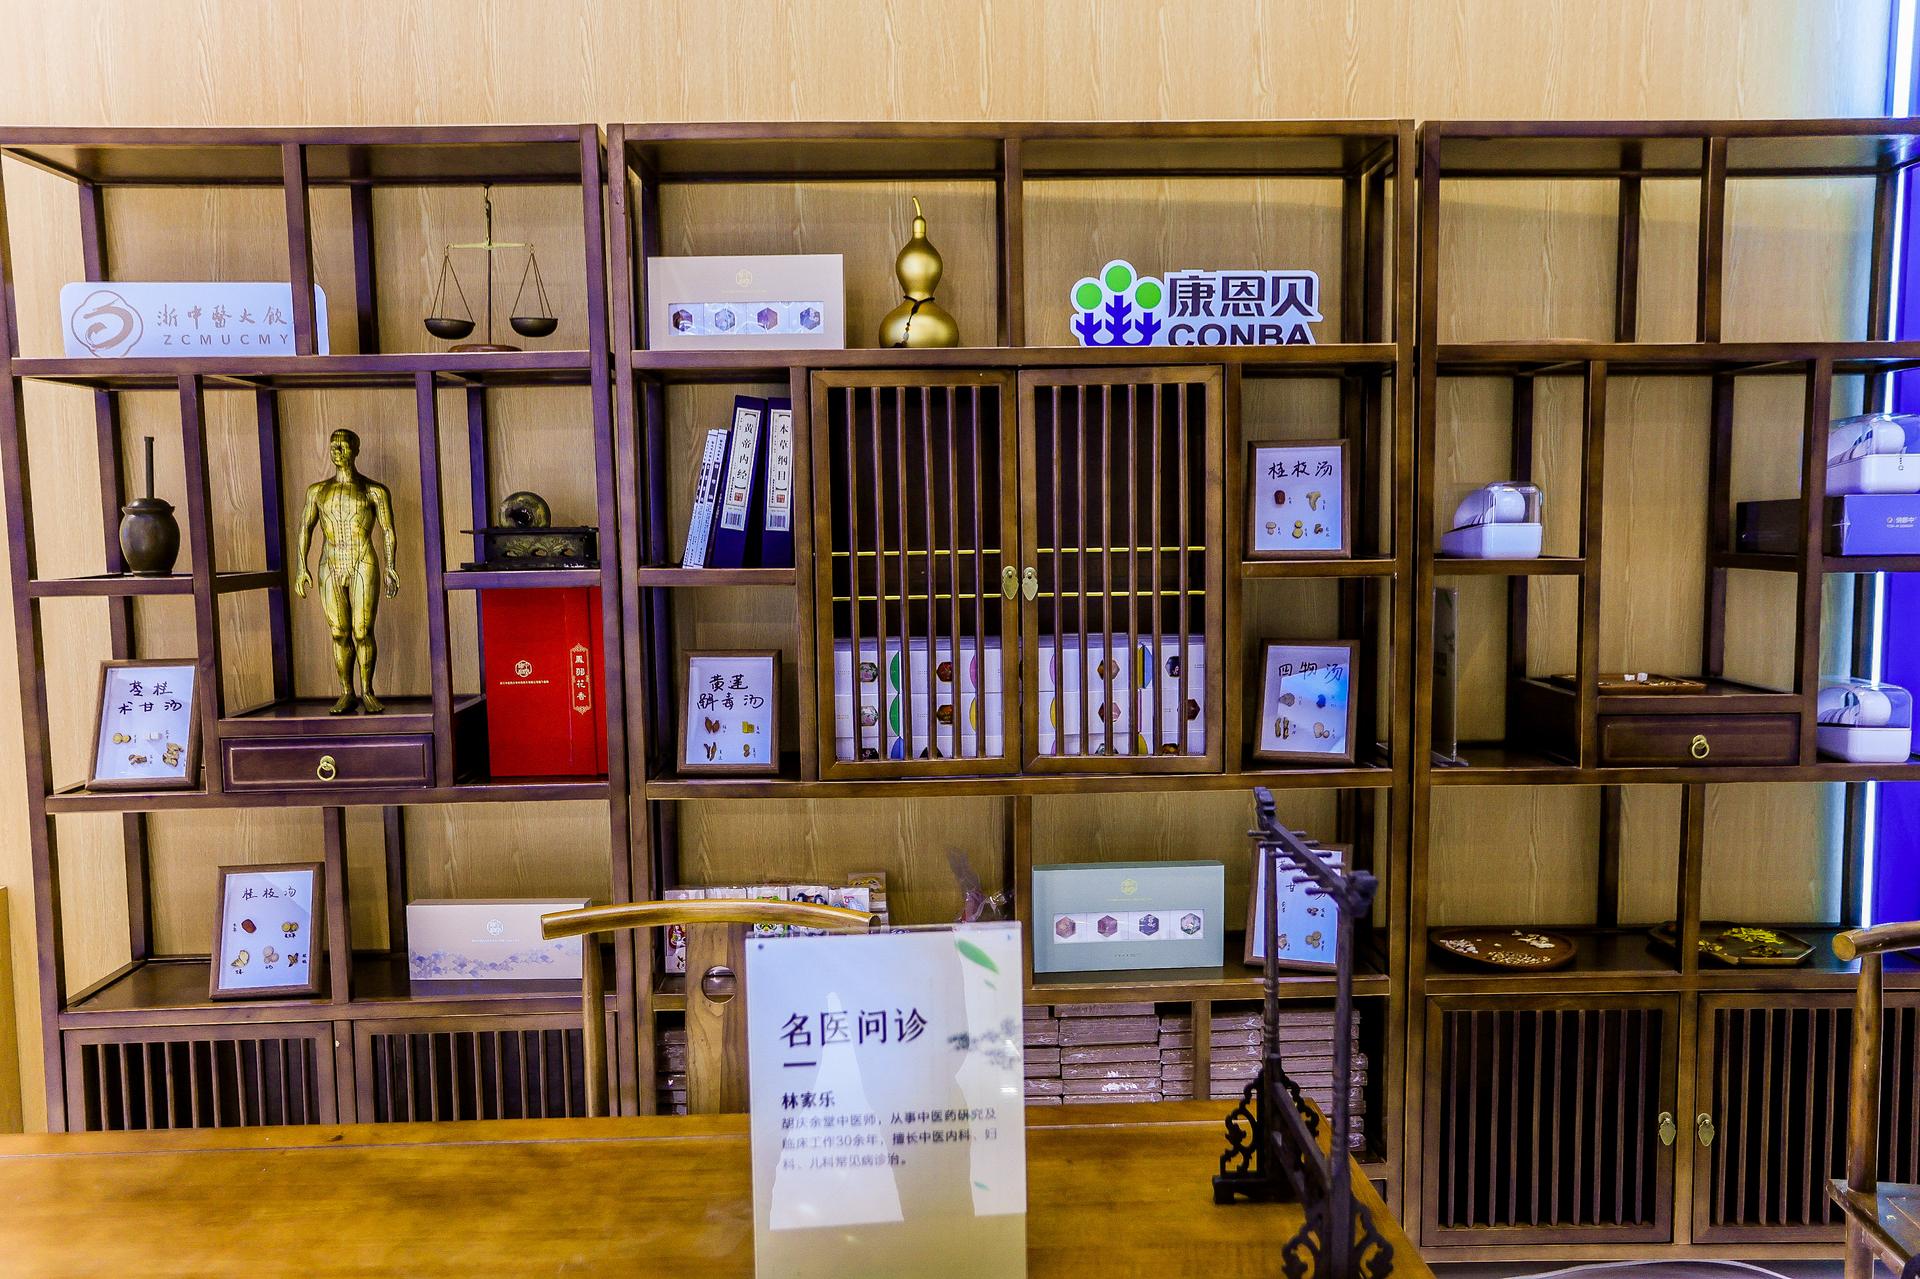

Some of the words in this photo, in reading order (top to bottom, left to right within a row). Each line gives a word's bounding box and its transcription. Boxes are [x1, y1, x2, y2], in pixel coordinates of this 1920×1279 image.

[1168, 275, 1314, 318] 康恩贝
[163, 334, 289, 346] ZCMUCMY
[1167, 323, 1312, 346] CONBA
[1267, 460, 1333, 480] 桂枝汤
[1278, 661, 1344, 683] 四物汤
[242, 886, 297, 901] 桂枝汤
[779, 1007, 928, 1048] 名医问诊
[781, 1091, 836, 1110] 林家乐
